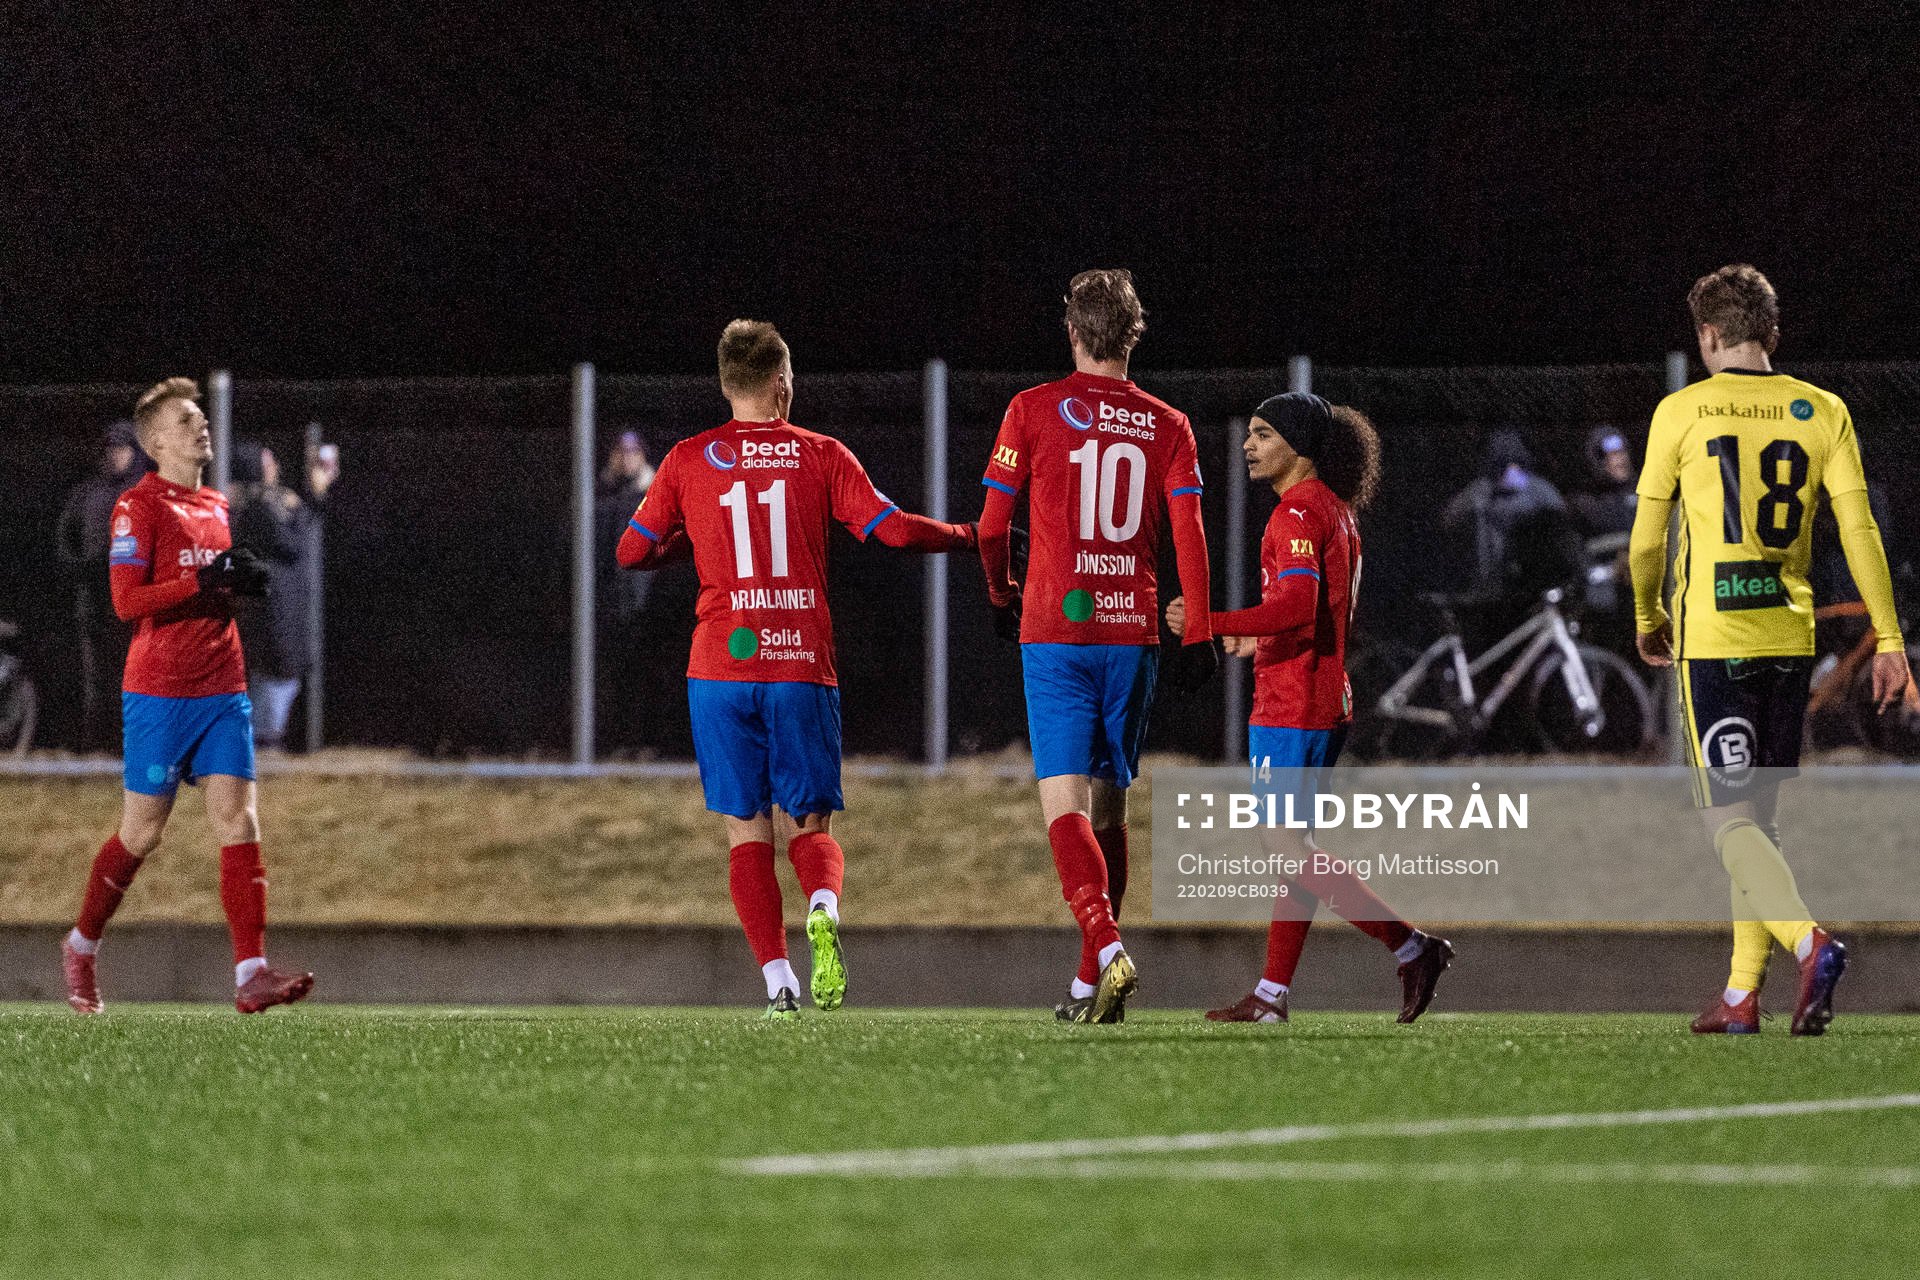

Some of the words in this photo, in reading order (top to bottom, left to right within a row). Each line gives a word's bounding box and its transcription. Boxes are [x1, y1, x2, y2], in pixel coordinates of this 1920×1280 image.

[1099, 401, 1156, 429] beat
[1697, 402, 1784, 420] Backahill
[1098, 420, 1155, 441] diabetes
[741, 439, 800, 456] beat
[993, 444, 1018, 468] XXL
[741, 456, 800, 469] diabetes
[1069, 439, 1147, 542] 10
[1706, 435, 1809, 549] 18
[719, 479, 788, 579] 11
[179, 544, 223, 567] ake
[1074, 549, 1136, 576] JÖNSSON
[1716, 574, 1778, 598] akea
[1095, 591, 1135, 609] Solid
[1095, 611, 1147, 627] Försäkring
[760, 628, 802, 647] Solid
[760, 648, 815, 663] Försäkring
[1251, 755, 1272, 784] 14
